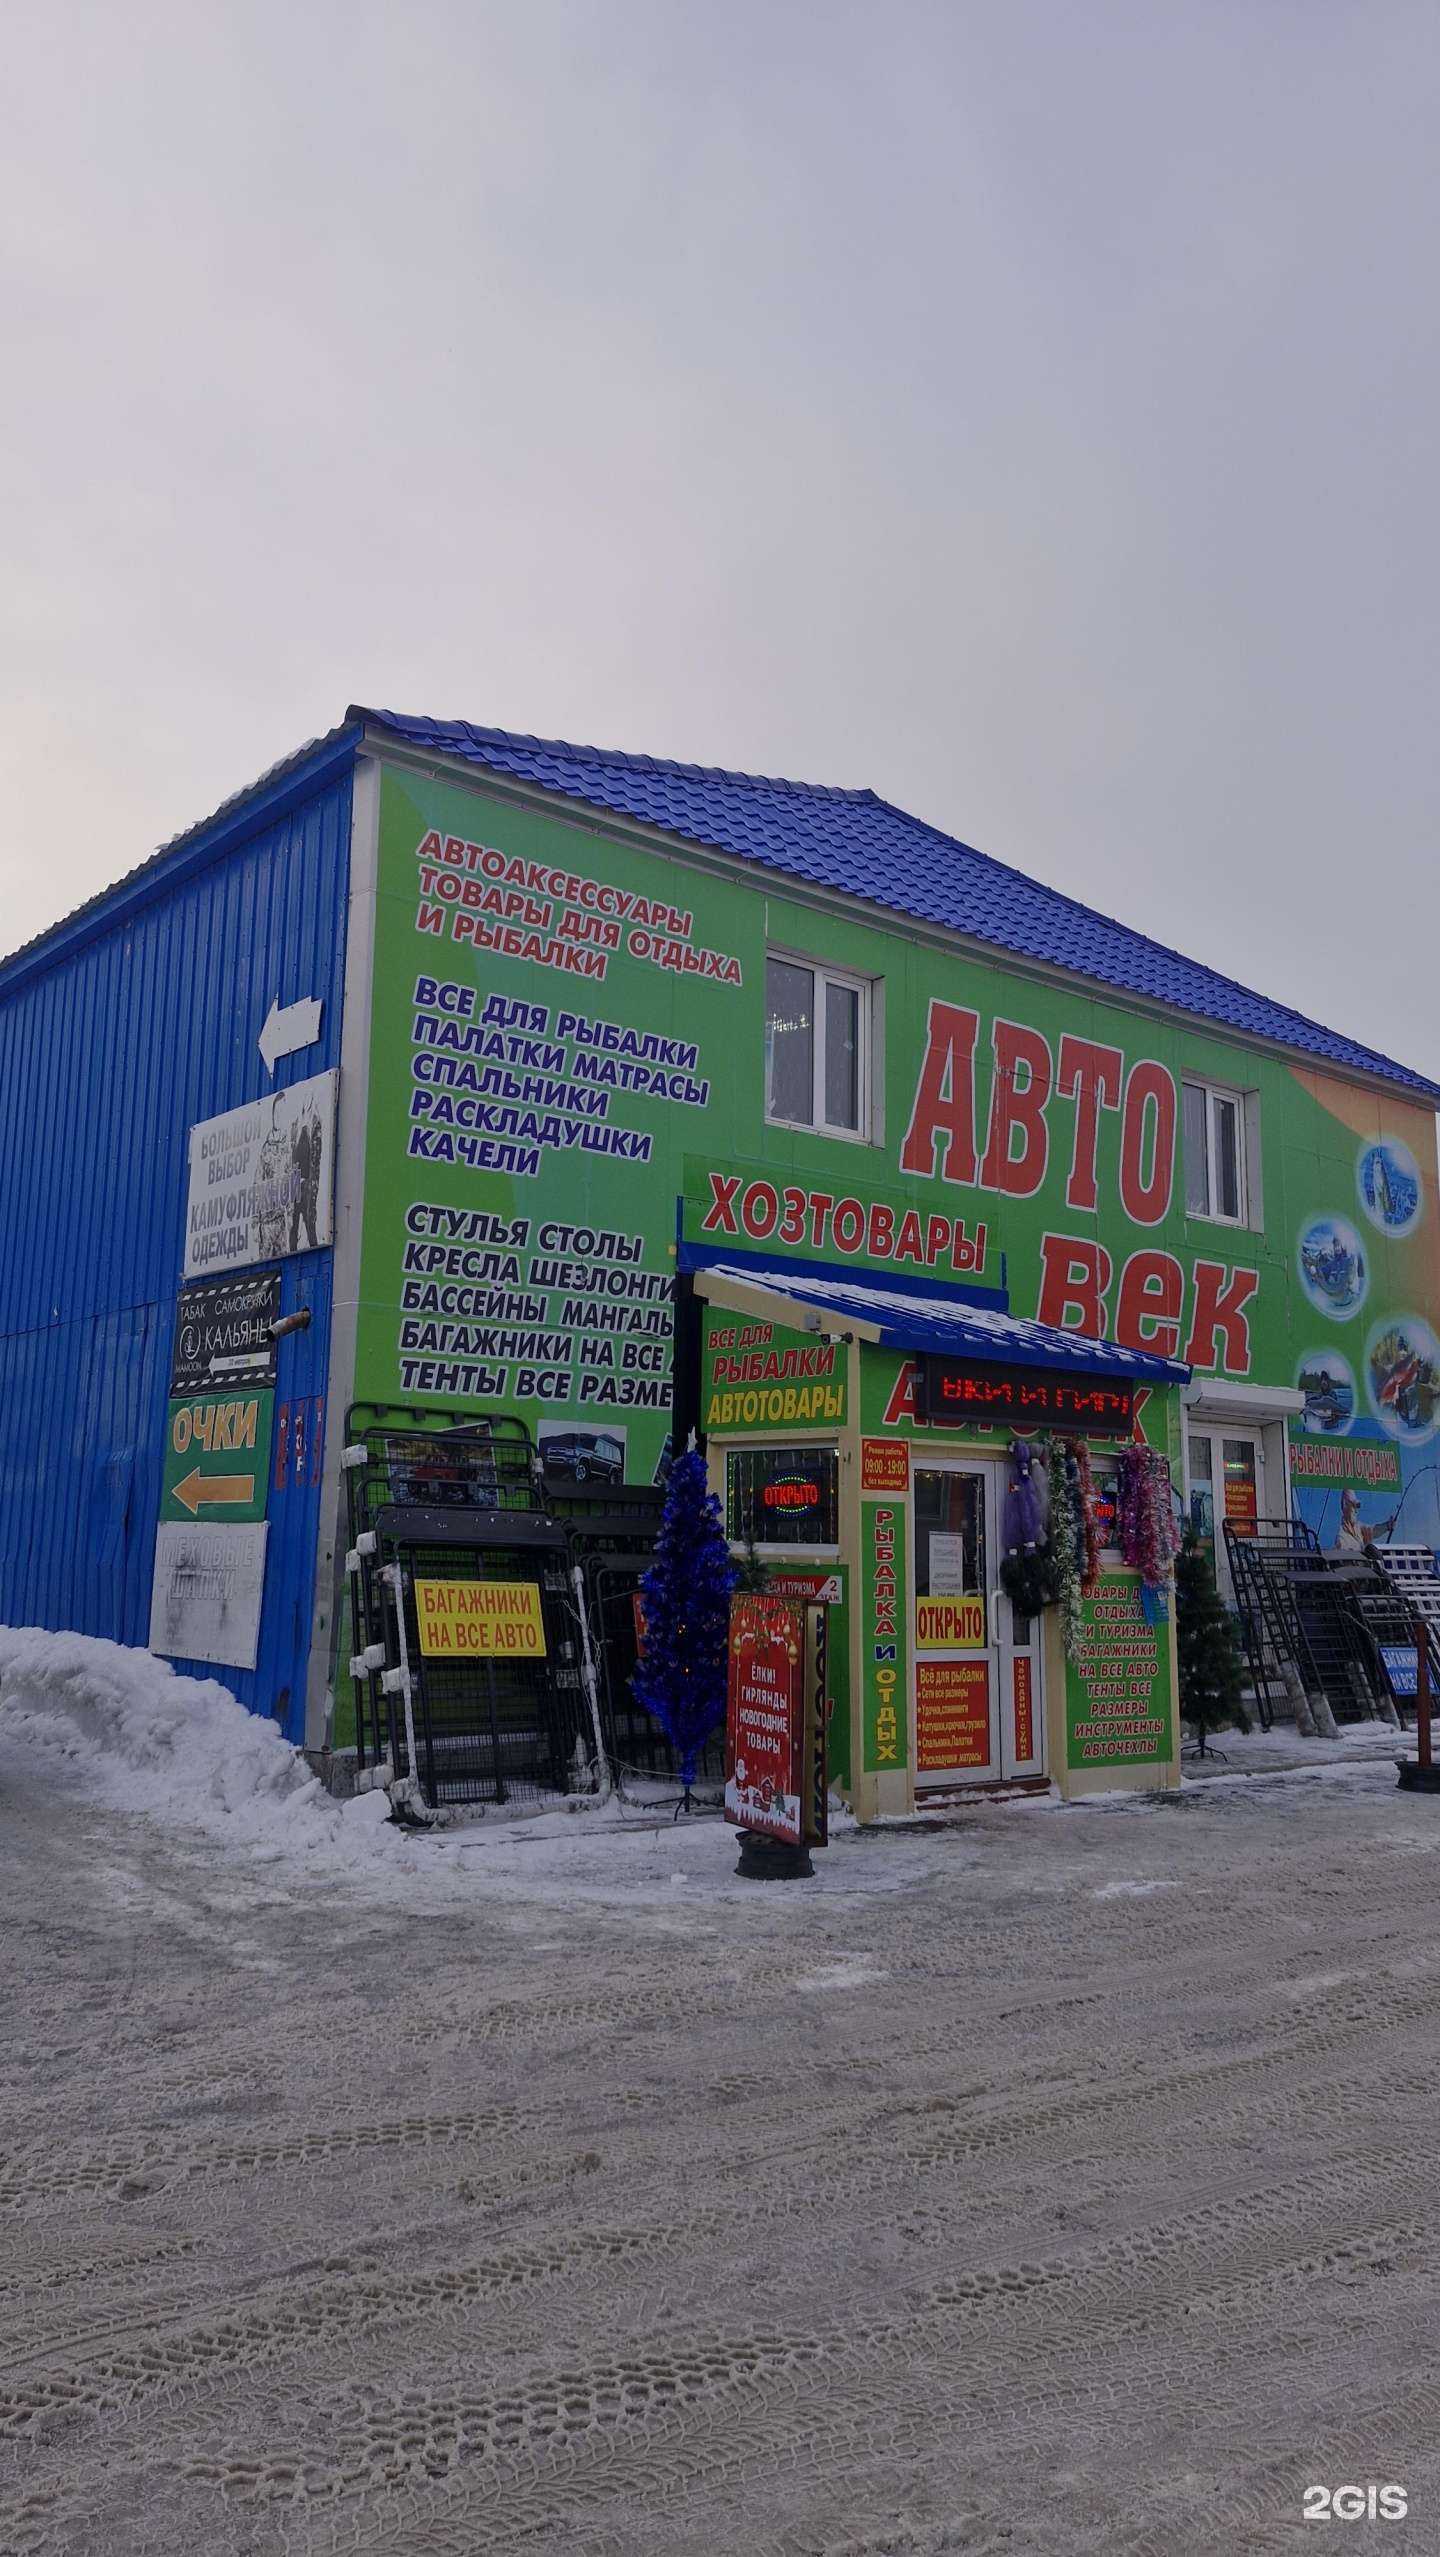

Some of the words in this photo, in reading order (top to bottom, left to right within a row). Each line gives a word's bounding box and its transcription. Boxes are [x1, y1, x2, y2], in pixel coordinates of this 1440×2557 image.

[418, 830, 692, 936] АВТОАКСЕССУАРЫ
[416, 902, 445, 935] И
[452, 914, 607, 980] РЫБАЛКИ
[419, 866, 552, 928] ТОВАРЫ
[557, 910, 620, 949] ДЛЯ
[627, 931, 743, 986] ОТДЫХА
[414, 976, 475, 1016] ВСЕ
[481, 994, 548, 1034] ДЛЯ
[556, 1013, 699, 1069] РЫБАЛКИ
[412, 1014, 565, 1074] ПАЛАТКИ
[571, 1053, 709, 1106] МАТРАСЫ
[412, 1053, 609, 1119] СПАЛЬНИКИ
[409, 1090, 653, 1163] РАСКЛАДУШКИ
[899, 998, 1177, 1227] АВТО
[208, 1148, 251, 1185] ВЫБОР
[407, 1128, 541, 1176] КАЧЕЛИ
[405, 1203, 531, 1249] СТУЛЬЯ
[537, 1222, 644, 1265] СТОЛЫ
[702, 1173, 987, 1274] ХОЗТОВАРЫ
[192, 1223, 248, 1265] ОДЕЖДЫ
[402, 1241, 521, 1285] КРЕСЛА
[528, 1257, 677, 1303] ШЕЗЛОНГИ
[180, 1303, 206, 1321] ТАБАК
[401, 1280, 548, 1324] БАССЕЙНЫ
[399, 1319, 574, 1364] БАГАЖНИКИ
[579, 1337, 615, 1368] НА
[620, 1342, 666, 1373] ВСЕ
[708, 1328, 736, 1350] ВСЕ
[739, 1323, 774, 1348] ДЛЯ
[713, 1345, 836, 1385] РЫБАЛКИ
[400, 1359, 508, 1397] ТЕНТЫ
[515, 1368, 572, 1401] ВСЕ
[578, 1374, 674, 1410] РАЗМЕ
[707, 1385, 844, 1424] АВТОТОВАРЫ
[172, 1400, 259, 1454] ОЧКИ
[865, 1458, 883, 1474] 09:00
[888, 1459, 906, 1476] 19:00
[1289, 1442, 1344, 1478] РЫБАЛКИ
[1343, 1447, 1353, 1478] И
[1355, 1448, 1397, 1485] ОТДЫХА
[764, 1484, 818, 1505] ОТКРЫТО
[829, 1580, 838, 1592] 2
[873, 1509, 897, 1636] РЫБАЛКА
[423, 1588, 532, 1617] БАГАЖНИКИ
[1082, 1586, 1128, 1600] ОВАРЫ
[918, 1606, 982, 1640] ОТКРЫТО
[1094, 1604, 1145, 1620] ОТДЫХА
[427, 1622, 450, 1648] НА
[456, 1622, 489, 1649] ВСЕ
[494, 1623, 537, 1649] АВТО
[1086, 1624, 1094, 1639] И
[1099, 1623, 1154, 1639] ТУРИЗМА
[874, 1644, 897, 1661] И
[1080, 1643, 1157, 1658] БАГАЖНИКИ
[751, 1661, 776, 1685] ЁЛКИ!
[1079, 1663, 1096, 1678] НА
[1101, 1662, 1123, 1678] ВСЕ
[1127, 1661, 1159, 1677] АВТО
[741, 1684, 788, 1710] ГИРЛЯНДЫ
[1087, 1682, 1125, 1698] ТЕНТЫ
[1130, 1681, 1152, 1696] ВСЕ
[739, 1708, 788, 1733] НОВОГОДНИЕ
[875, 1668, 898, 1760] ОТДЫХ
[1090, 1700, 1148, 1717] РАЗМЕРЫ
[747, 1731, 781, 1755] ТОВАРЫ
[1075, 1719, 1164, 1738] ИНСТРУМЕНТЫ
[1082, 1739, 1159, 1758] АВТОЧЕХЛЫ
